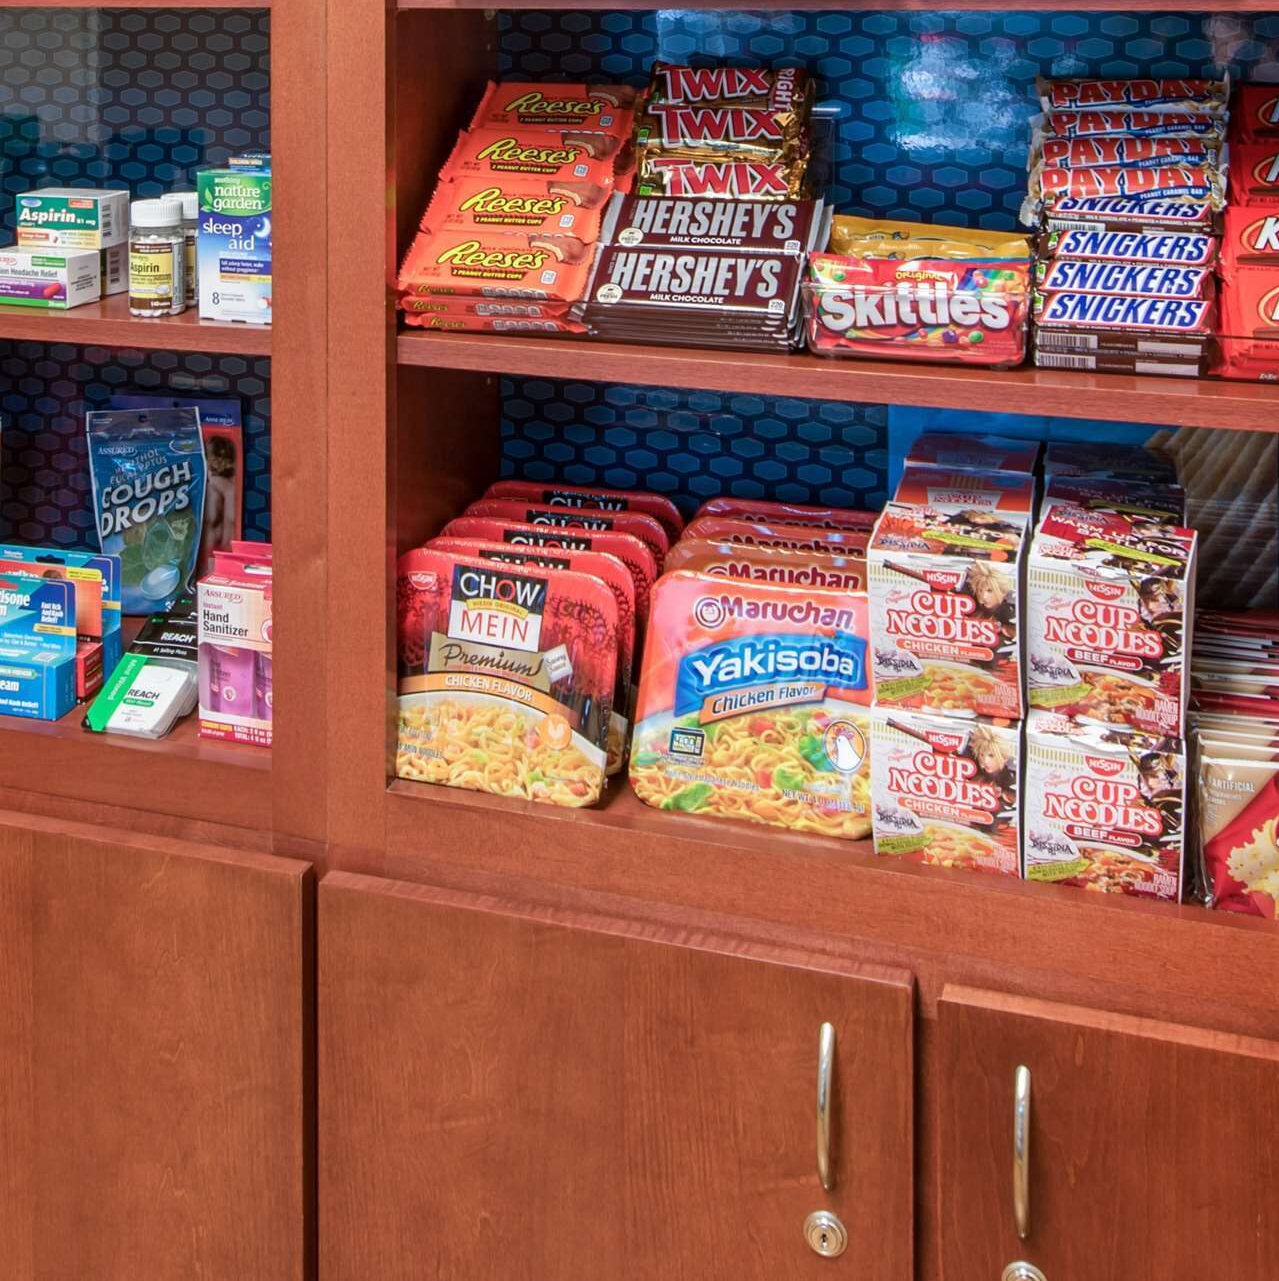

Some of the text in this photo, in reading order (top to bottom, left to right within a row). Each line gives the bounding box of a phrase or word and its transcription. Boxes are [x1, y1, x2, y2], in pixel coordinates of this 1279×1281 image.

[656, 67, 771, 104] TWIX
[1051, 79, 1212, 108] PAYDAY
[505, 92, 605, 117] Reese's
[648, 105, 785, 148] TWIX
[1050, 111, 1213, 136] PAYDAY
[476, 138, 582, 165] Reese's
[1042, 138, 1207, 168] PAYDAY
[214, 185, 261, 197] nature
[650, 159, 790, 198] TWIX
[1040, 168, 1212, 200] PAYDAY
[213, 198, 262, 211] garden
[458, 187, 568, 215] Reese's
[1060, 198, 1204, 218] SNICKERS
[1140, 188, 1203, 200] PEANUT CARAMEL BAR
[19, 208, 76, 224] Aspirin
[203, 218, 242, 238] sleep
[631, 199, 797, 240] HERSHEY'S
[228, 235, 254, 251] aid
[437, 239, 549, 270] Reese's
[669, 236, 742, 246] MILK CHOCOLATE
[1063, 230, 1209, 262] SNICKERS
[458, 270, 522, 280] PEANUT BUTTER CUPS
[610, 252, 782, 299] HERSHEY'S
[1049, 261, 1202, 295] SNICKERS
[212, 292, 220, 306] 8
[650, 292, 724, 304] MILK CHOCOLATE
[821, 281, 1010, 332] Skittles
[1049, 294, 1204, 328] SNICKERS
[102, 461, 192, 509] COUGH
[101, 484, 190, 538] DROPS
[460, 572, 541, 607] CHOW
[722, 563, 860, 590] Maruchan
[926, 572, 958, 584] NISSIN
[203, 610, 229, 623] Hand
[720, 595, 854, 629] Maruchan
[913, 592, 974, 618] CUP
[1073, 600, 1138, 630] CUP
[160, 632, 195, 643] REACH
[203, 622, 248, 637] Sanitizer
[461, 609, 530, 643] MEIN
[888, 611, 998, 645] NOODLES
[1046, 618, 1162, 656] NOODLES
[439, 642, 544, 677] Premium
[904, 640, 985, 659] CHICKEN FLAVOR
[1075, 650, 1137, 669] BEEF FLAVOR
[692, 643, 854, 687] Yakisoba
[127, 688, 160, 700] REACH
[445, 675, 533, 702] CHICKEN FLAVOR
[712, 686, 815, 715] Chicken Flavor
[914, 751, 976, 780] CUP
[889, 768, 999, 810] NOODLES
[1072, 778, 1138, 806] CUP
[904, 798, 961, 815] CHICKEN
[1045, 793, 1161, 834] NOODLES
[1073, 826, 1136, 844] BEEF FLAVOR
